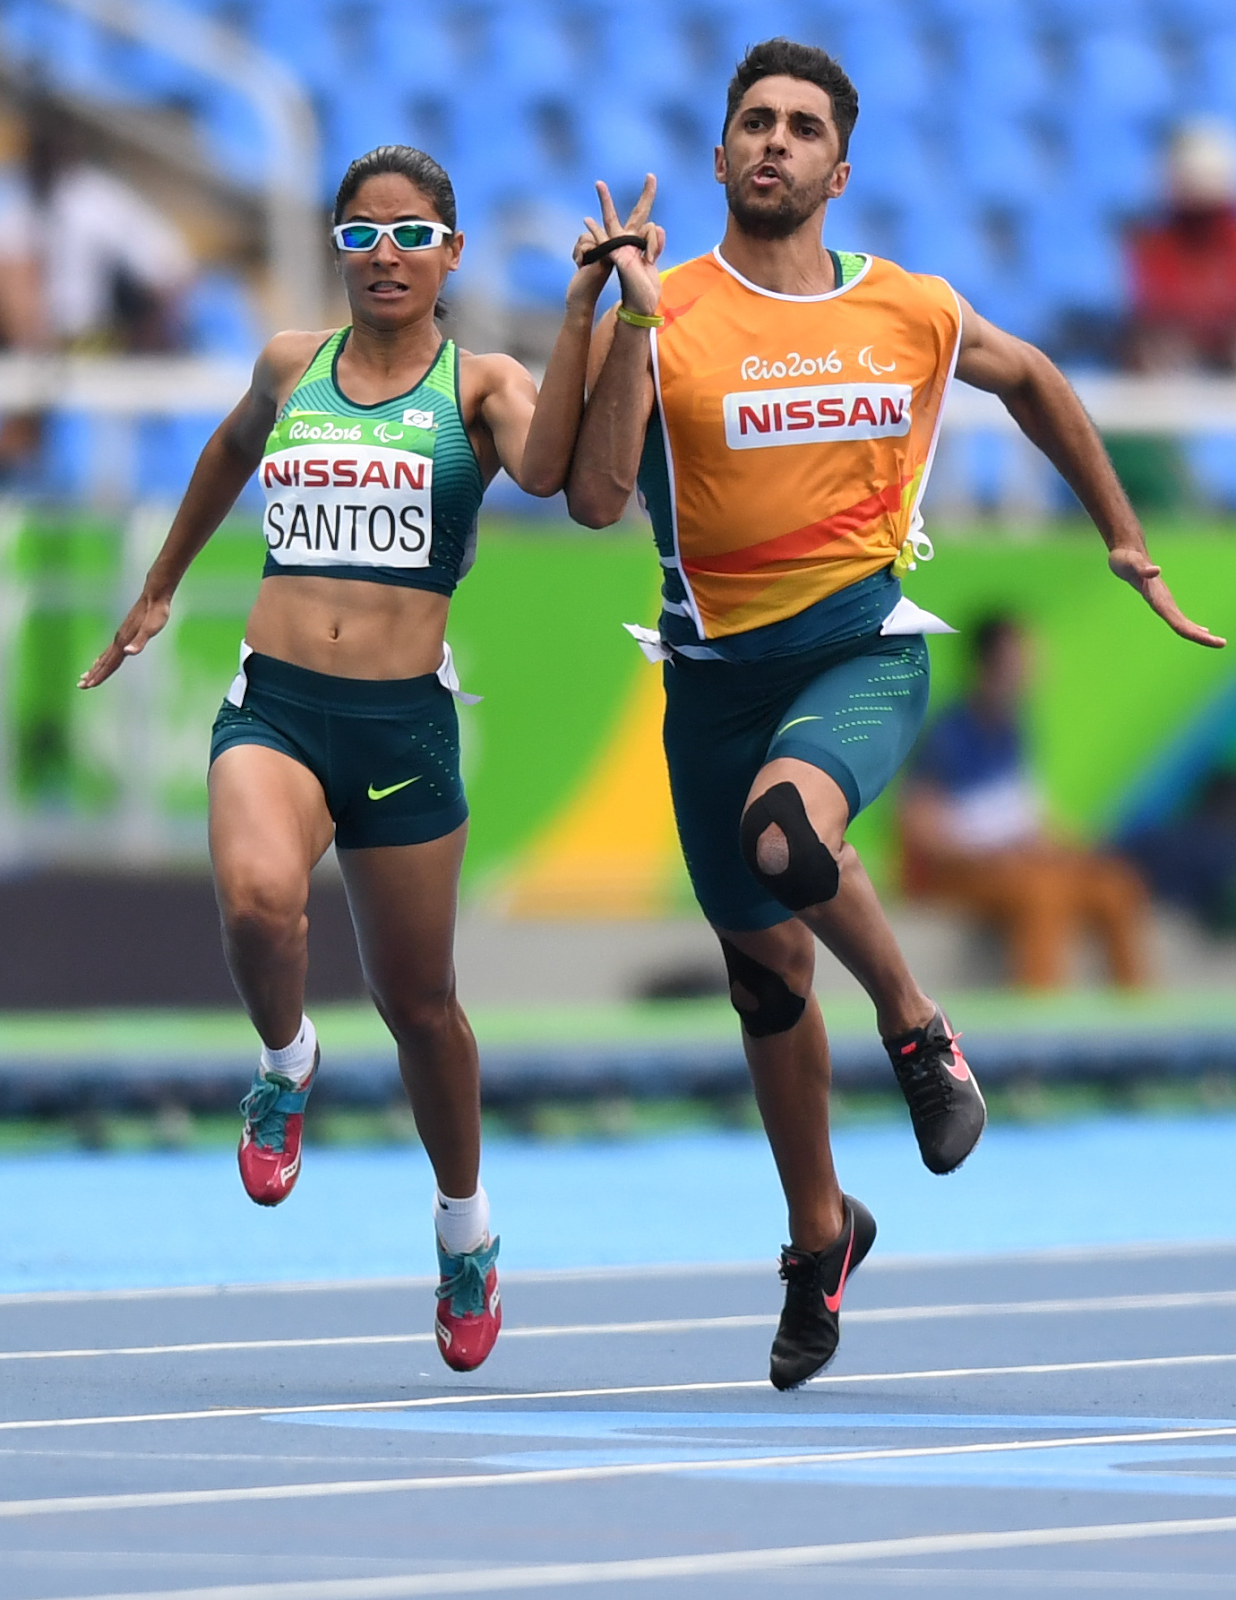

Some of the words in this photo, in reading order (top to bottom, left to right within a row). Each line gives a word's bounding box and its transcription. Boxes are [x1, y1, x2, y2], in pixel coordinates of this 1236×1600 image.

[740, 349, 843, 381] Rio2016
[288, 420, 362, 441] Rio2016
[738, 397, 904, 435] NISSAN
[264, 459, 425, 490] NISSAN
[265, 502, 426, 552] SANTOS
